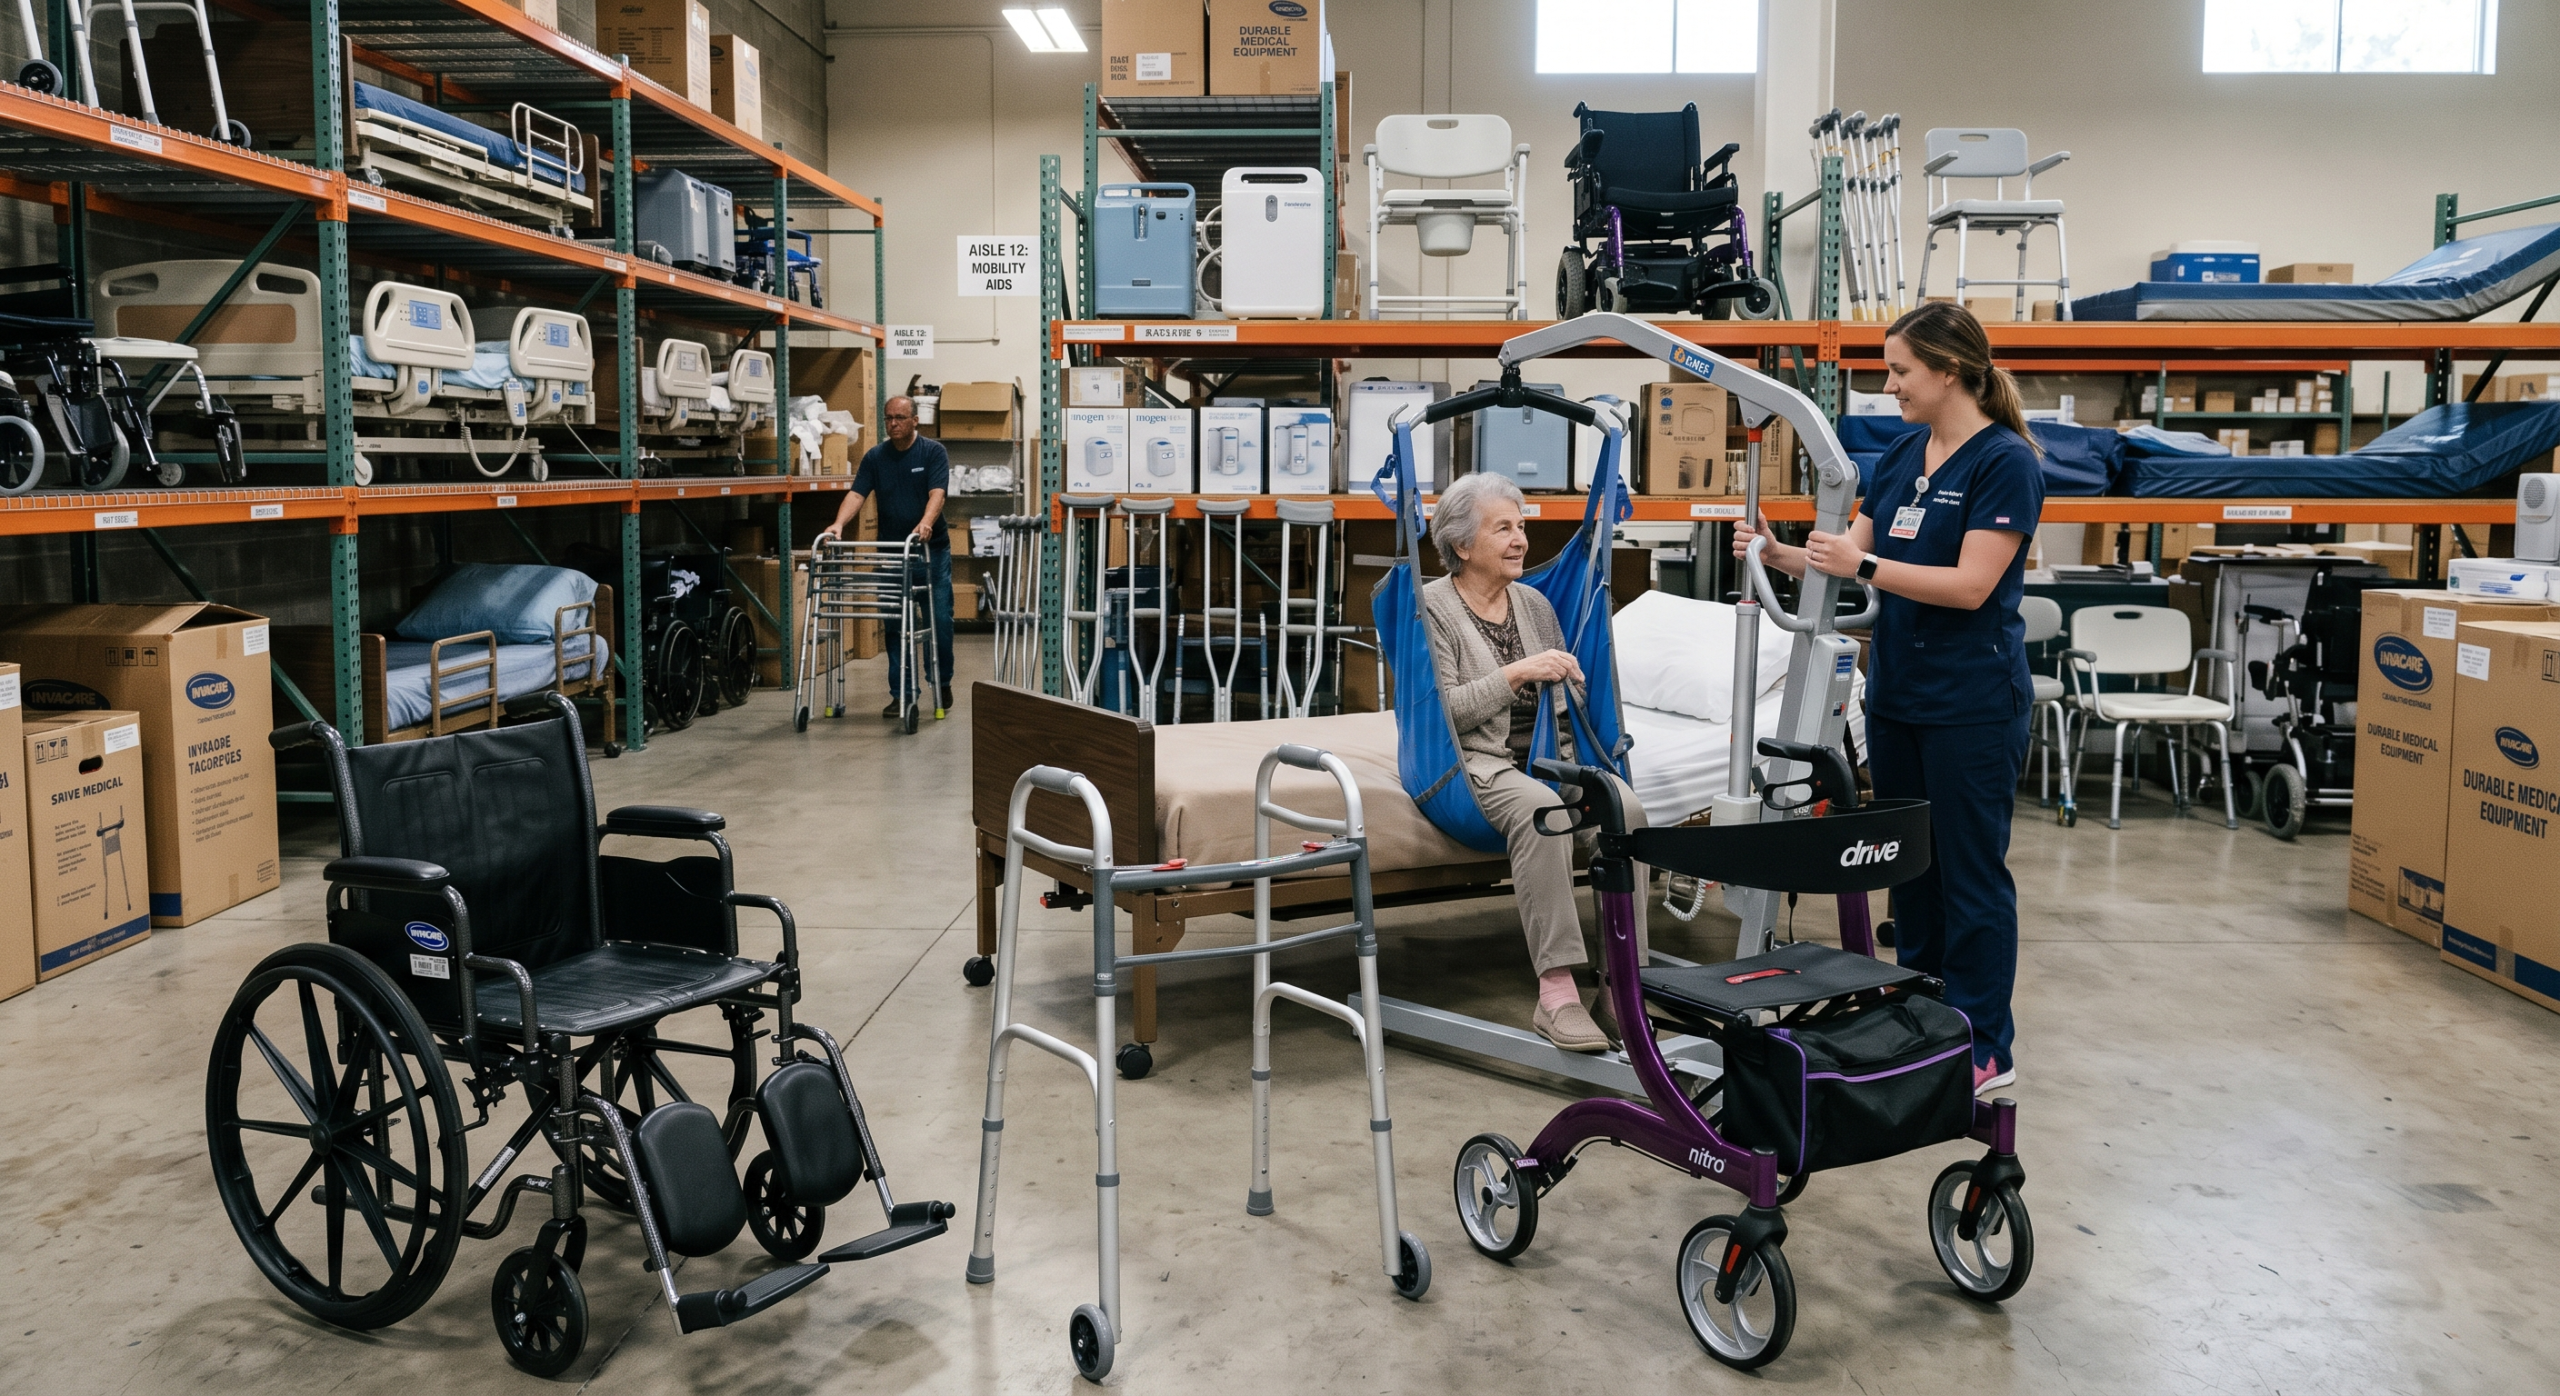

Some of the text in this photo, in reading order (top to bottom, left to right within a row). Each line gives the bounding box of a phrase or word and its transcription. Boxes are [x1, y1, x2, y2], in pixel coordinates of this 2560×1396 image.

[1239, 26, 1291, 36] DURABLE
[1240, 36, 1290, 46] MEDICAL
[1233, 47, 1298, 57] EQUIPMENT
[969, 244, 1028, 256] AISLE 12:
[972, 262, 1026, 274] MOBILITY
[985, 279, 1013, 290] AIDS
[894, 329, 914, 337] AISLE
[2380, 650, 2424, 674] INVACARE
[31, 691, 96, 705] INVACARE
[2367, 722, 2438, 752] DURABLE MEDICAL
[83, 776, 123, 797] MEDICAL
[2463, 768, 2515, 802] DURABLE
[2480, 800, 2548, 839] EQUIPMENT
[1840, 840, 1900, 867] drive
[1688, 1147, 1725, 1174] nitro
